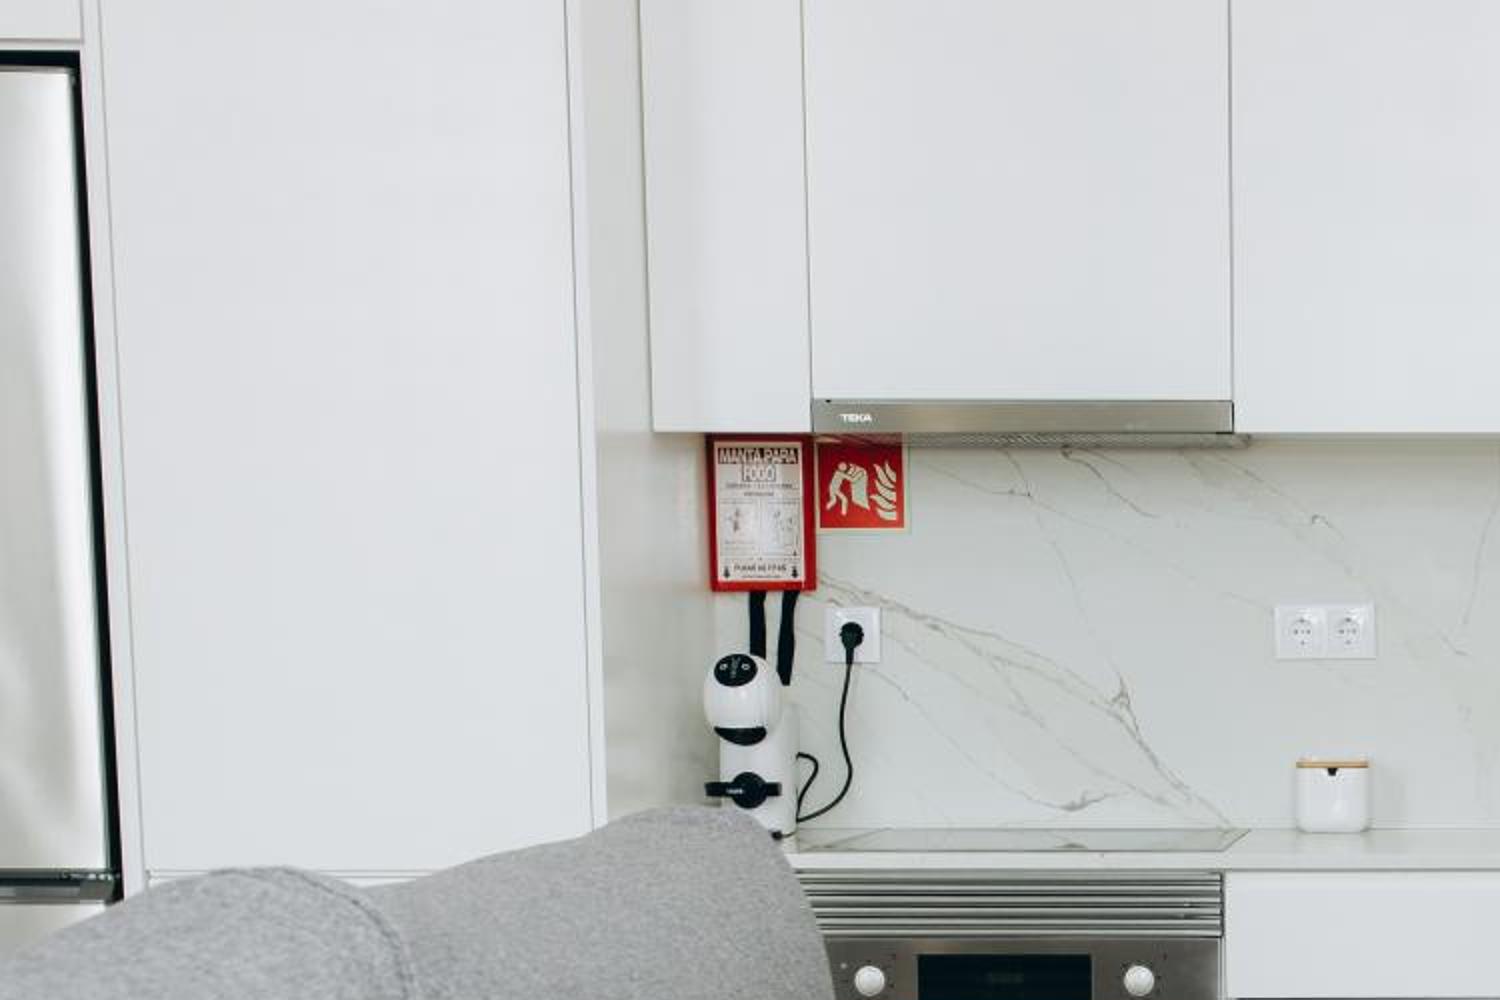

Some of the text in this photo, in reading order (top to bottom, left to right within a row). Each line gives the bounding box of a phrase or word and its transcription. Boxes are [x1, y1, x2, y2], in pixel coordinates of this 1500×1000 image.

[839, 413, 872, 424] TEKA
[719, 448, 798, 464] MANTA PARA
